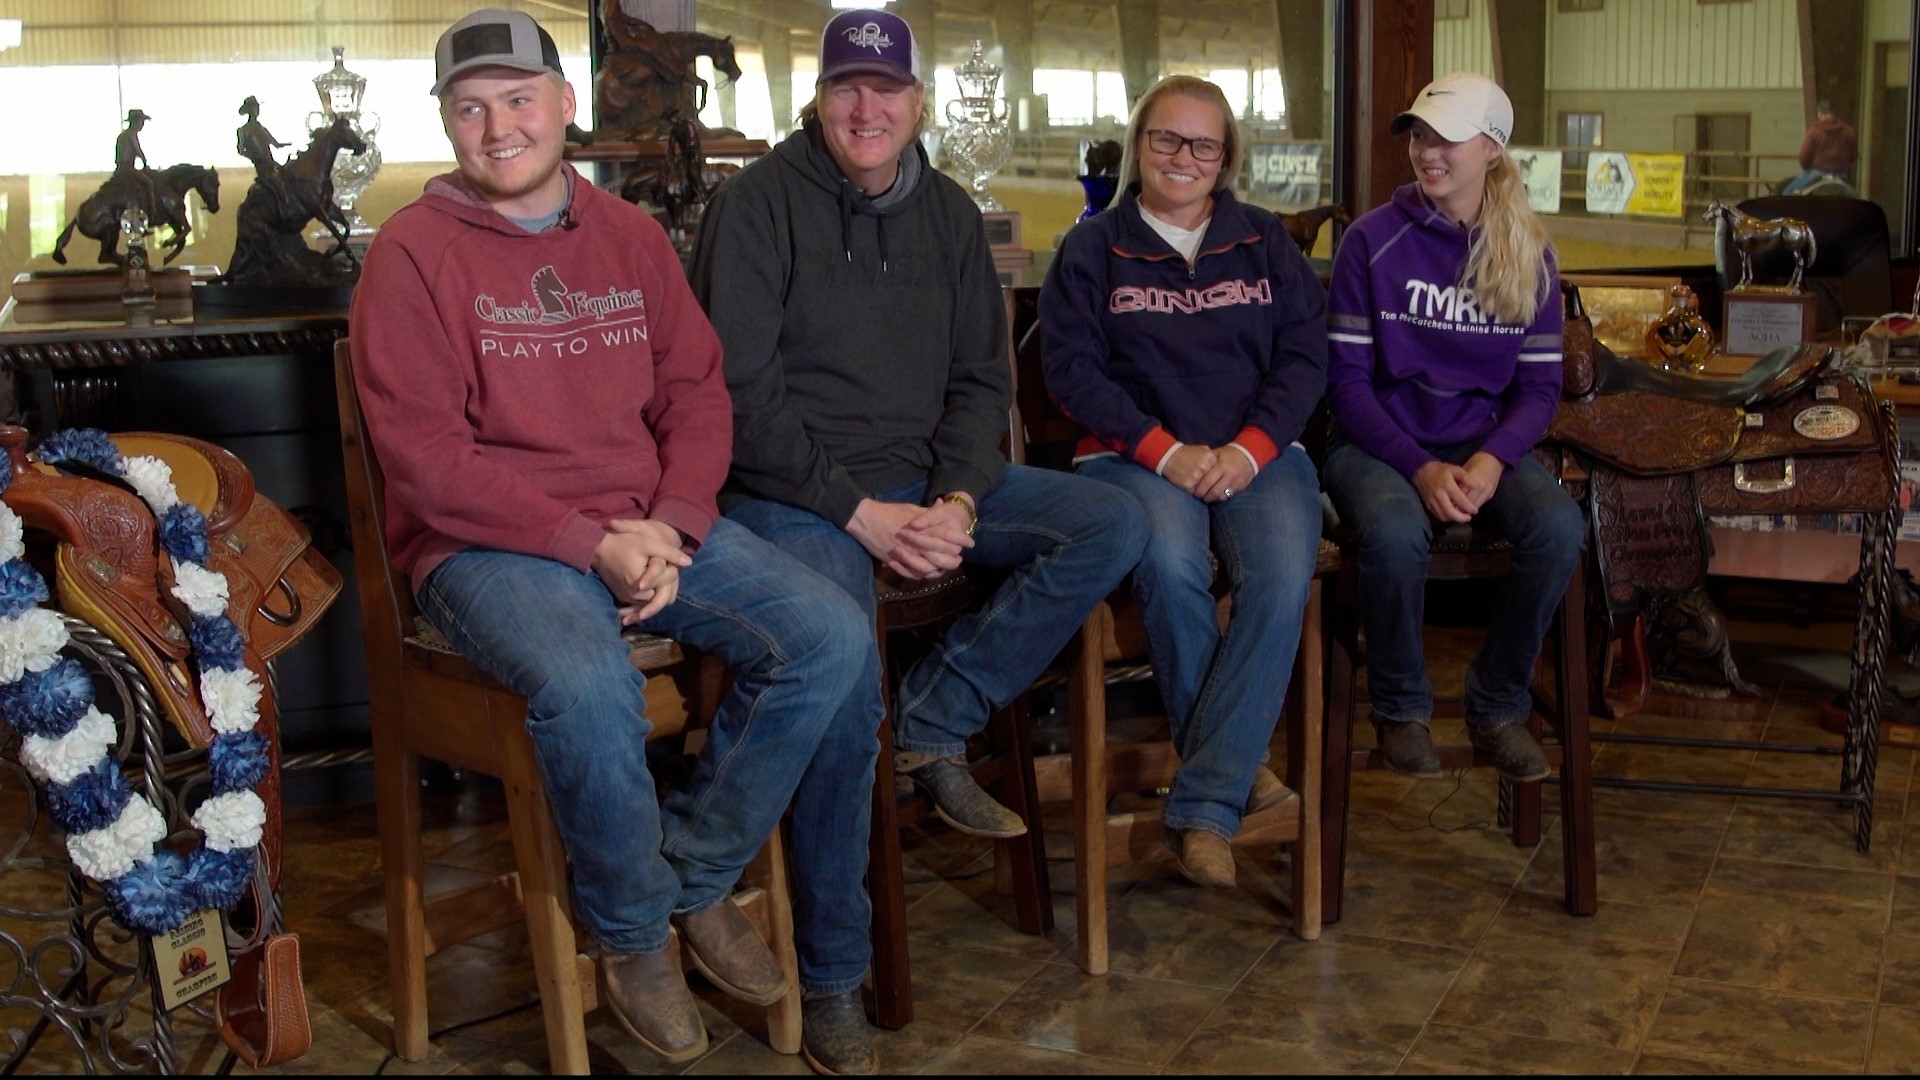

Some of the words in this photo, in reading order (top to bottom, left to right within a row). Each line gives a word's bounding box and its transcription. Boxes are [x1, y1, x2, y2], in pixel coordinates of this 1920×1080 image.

[1267, 154, 1319, 175] CINCH
[475, 293, 540, 324] Classic
[566, 285, 644, 321] Equine
[1110, 278, 1272, 314] CINCH
[1380, 311, 1397, 320] Tom
[1399, 312, 1452, 330] McCutcheon
[1455, 322, 1490, 334] Reining
[1492, 325, 1525, 335] Horses
[481, 339, 541, 358] PLAY
[552, 337, 588, 358] TO
[601, 325, 648, 346] WIN
[176, 971, 218, 998] CHAMPION
